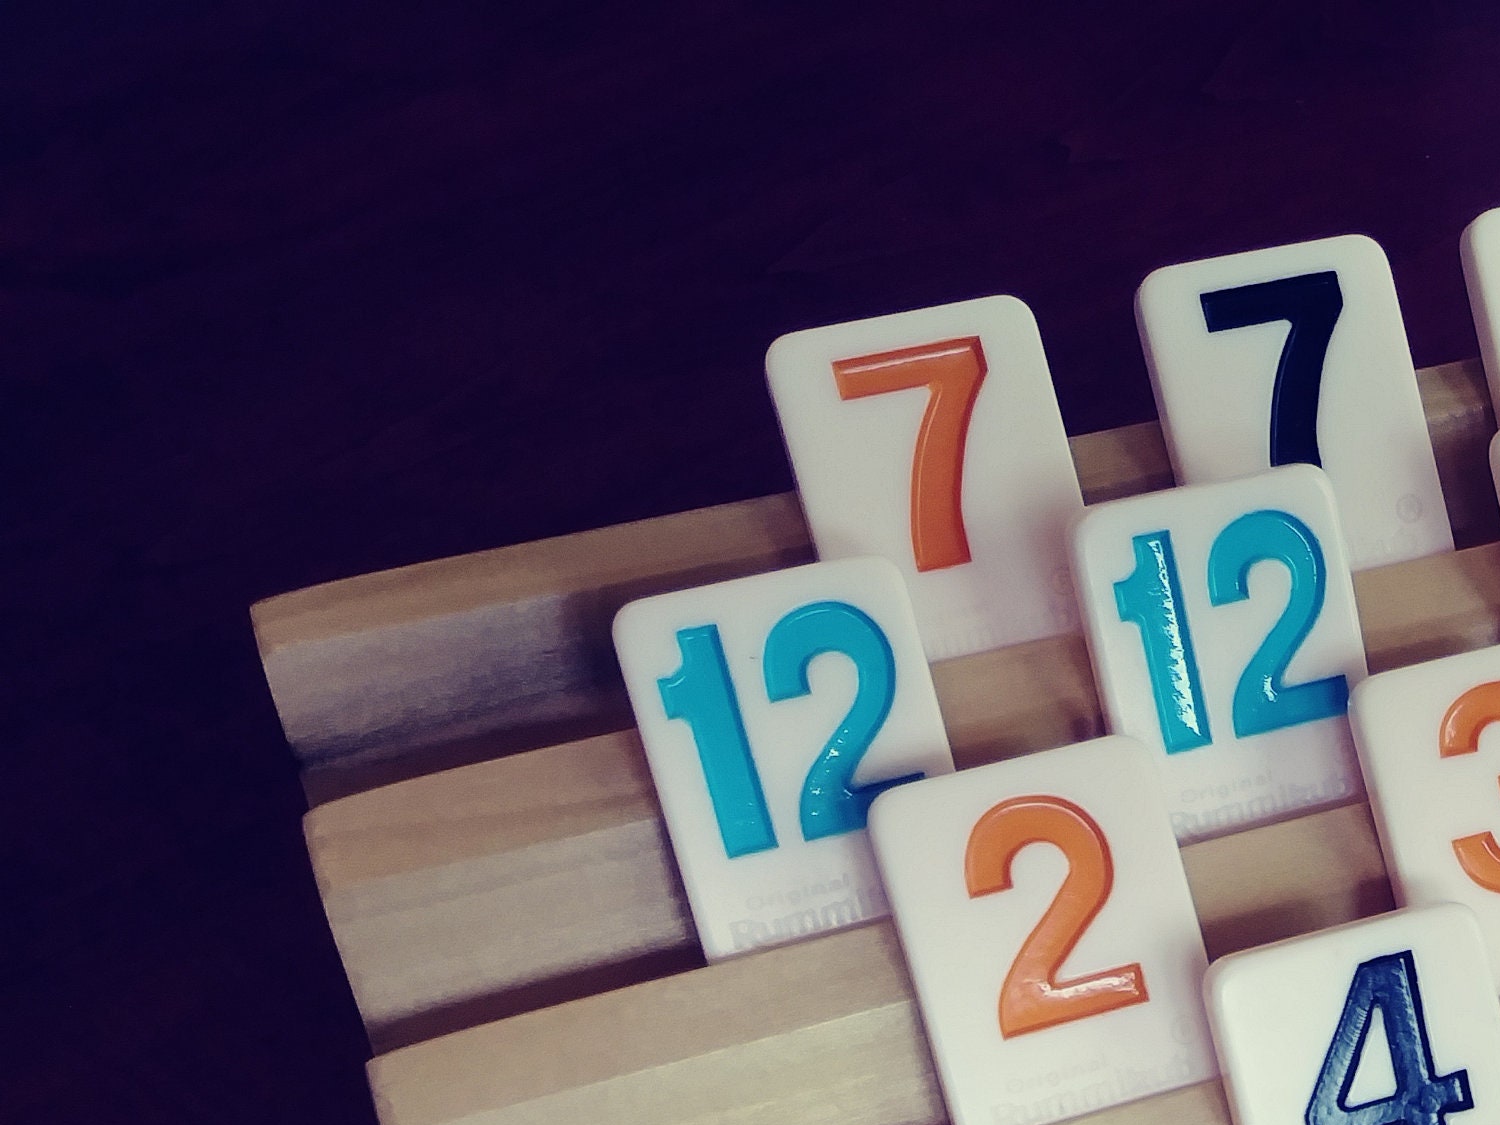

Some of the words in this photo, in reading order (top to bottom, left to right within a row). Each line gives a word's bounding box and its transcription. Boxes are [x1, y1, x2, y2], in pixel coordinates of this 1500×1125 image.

[833, 336, 987, 572] 7
[1200, 271, 1343, 468] 7
[656, 600, 926, 859] 12
[1113, 509, 1348, 756] 12
[965, 796, 1148, 1039] 2
